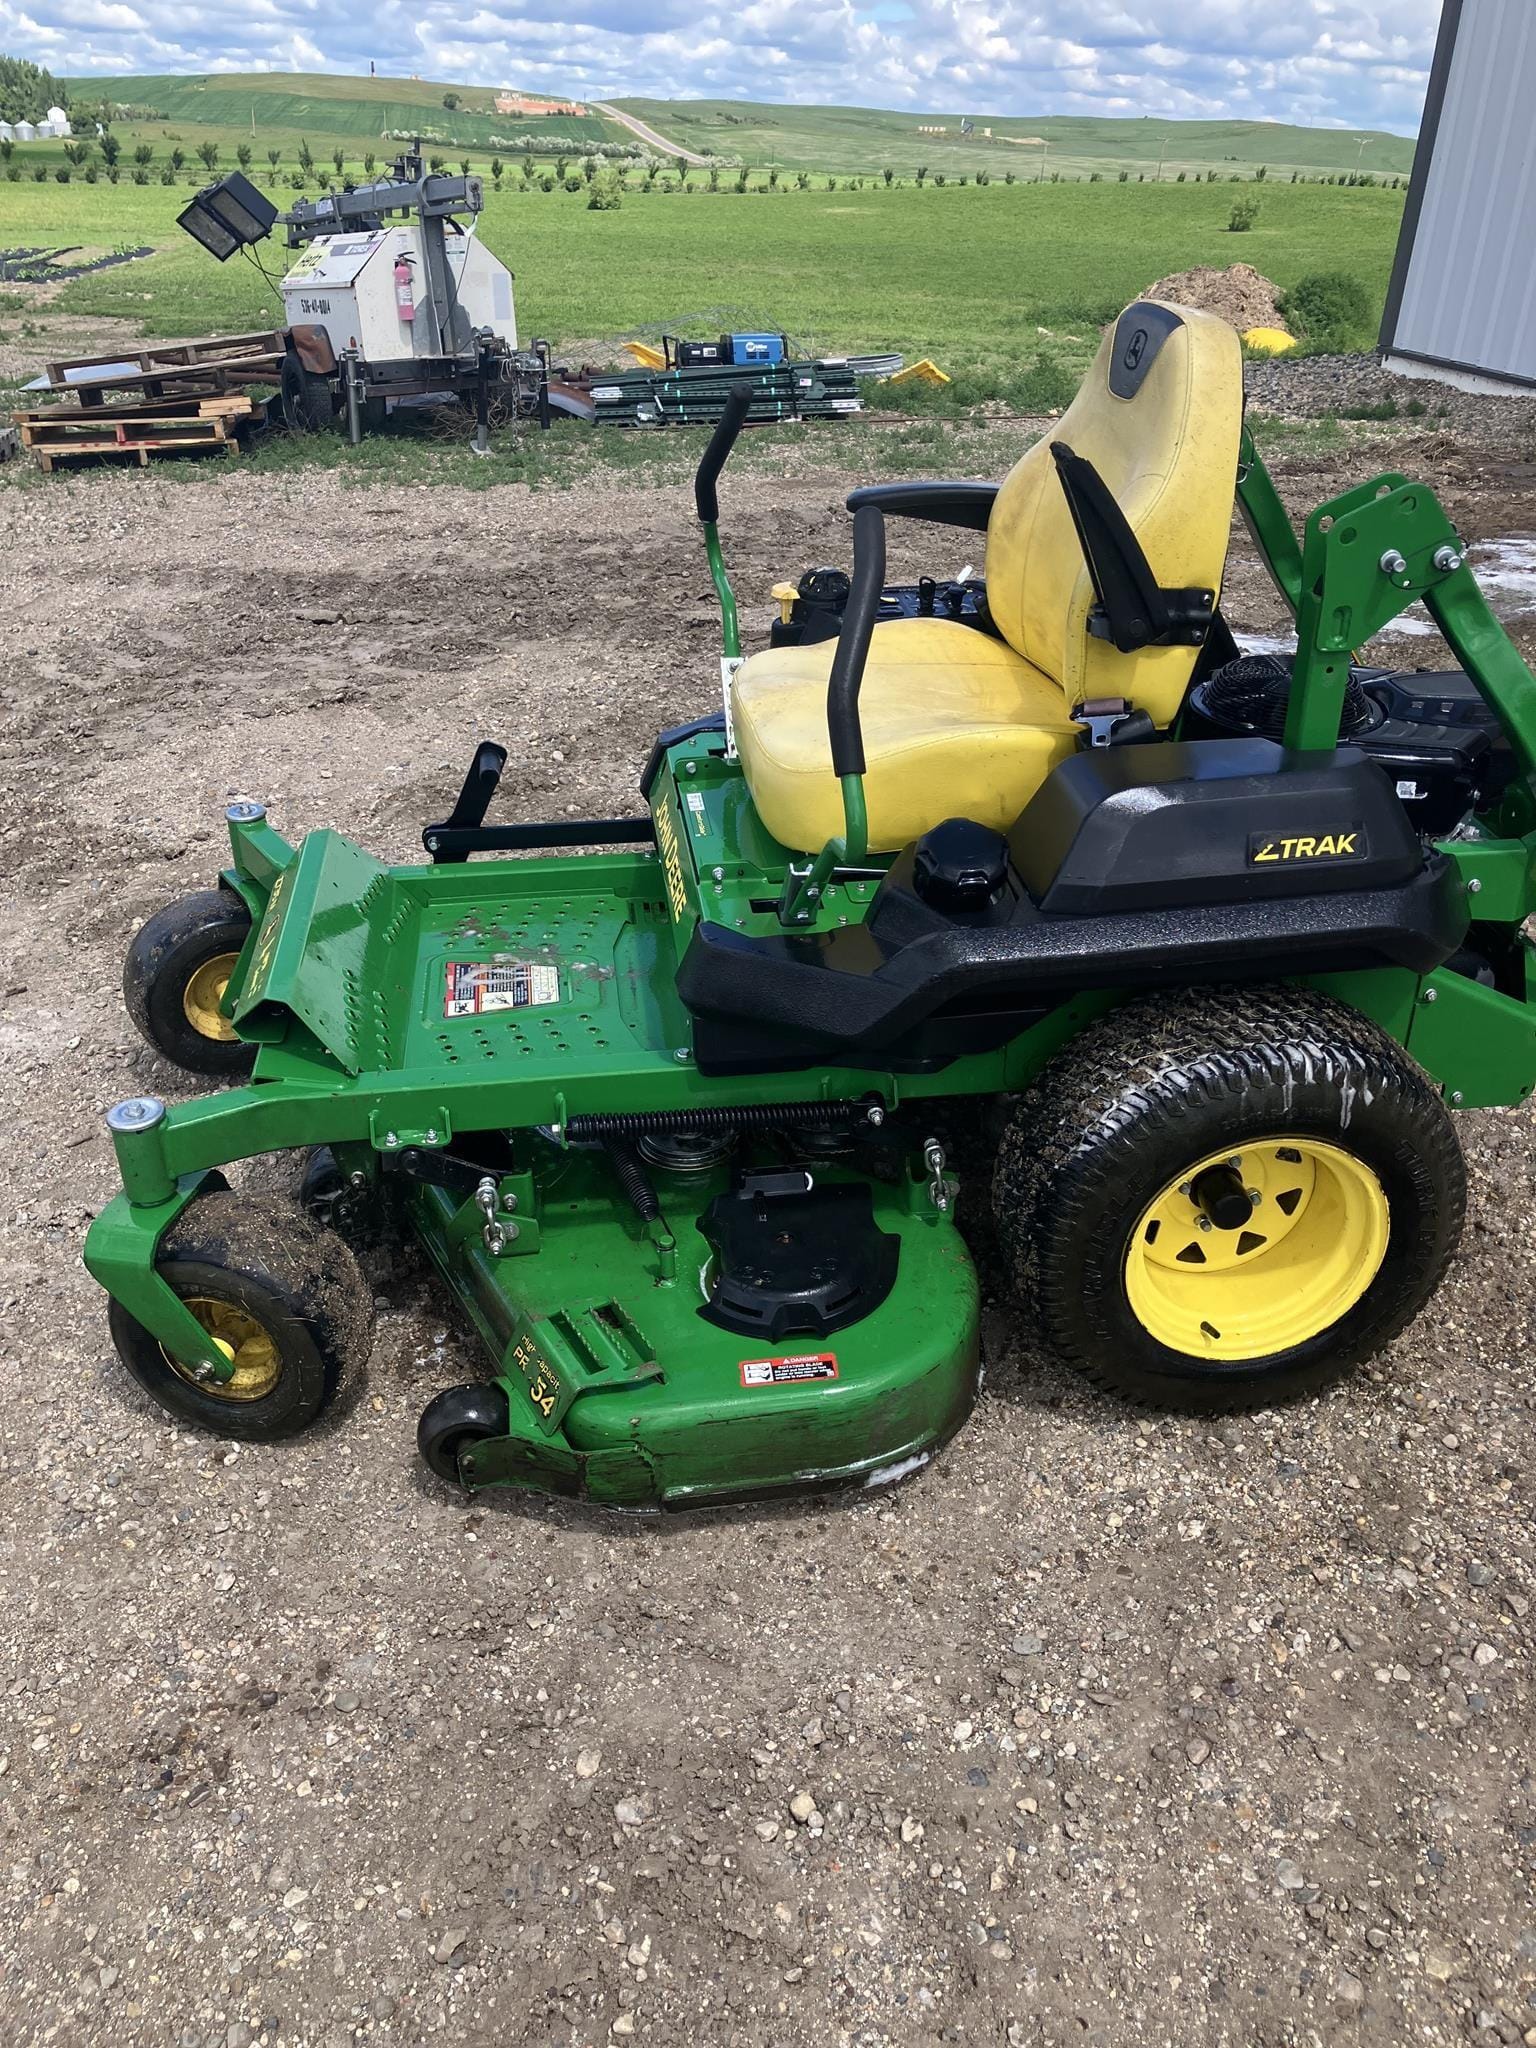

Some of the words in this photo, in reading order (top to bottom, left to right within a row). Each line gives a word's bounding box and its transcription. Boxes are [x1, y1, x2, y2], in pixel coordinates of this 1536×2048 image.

[657, 793, 674, 855] JOHN
[665, 836, 687, 923] DEERE
[1394, 1139, 1440, 1218] TURF
[530, 1375, 555, 1417] 54
